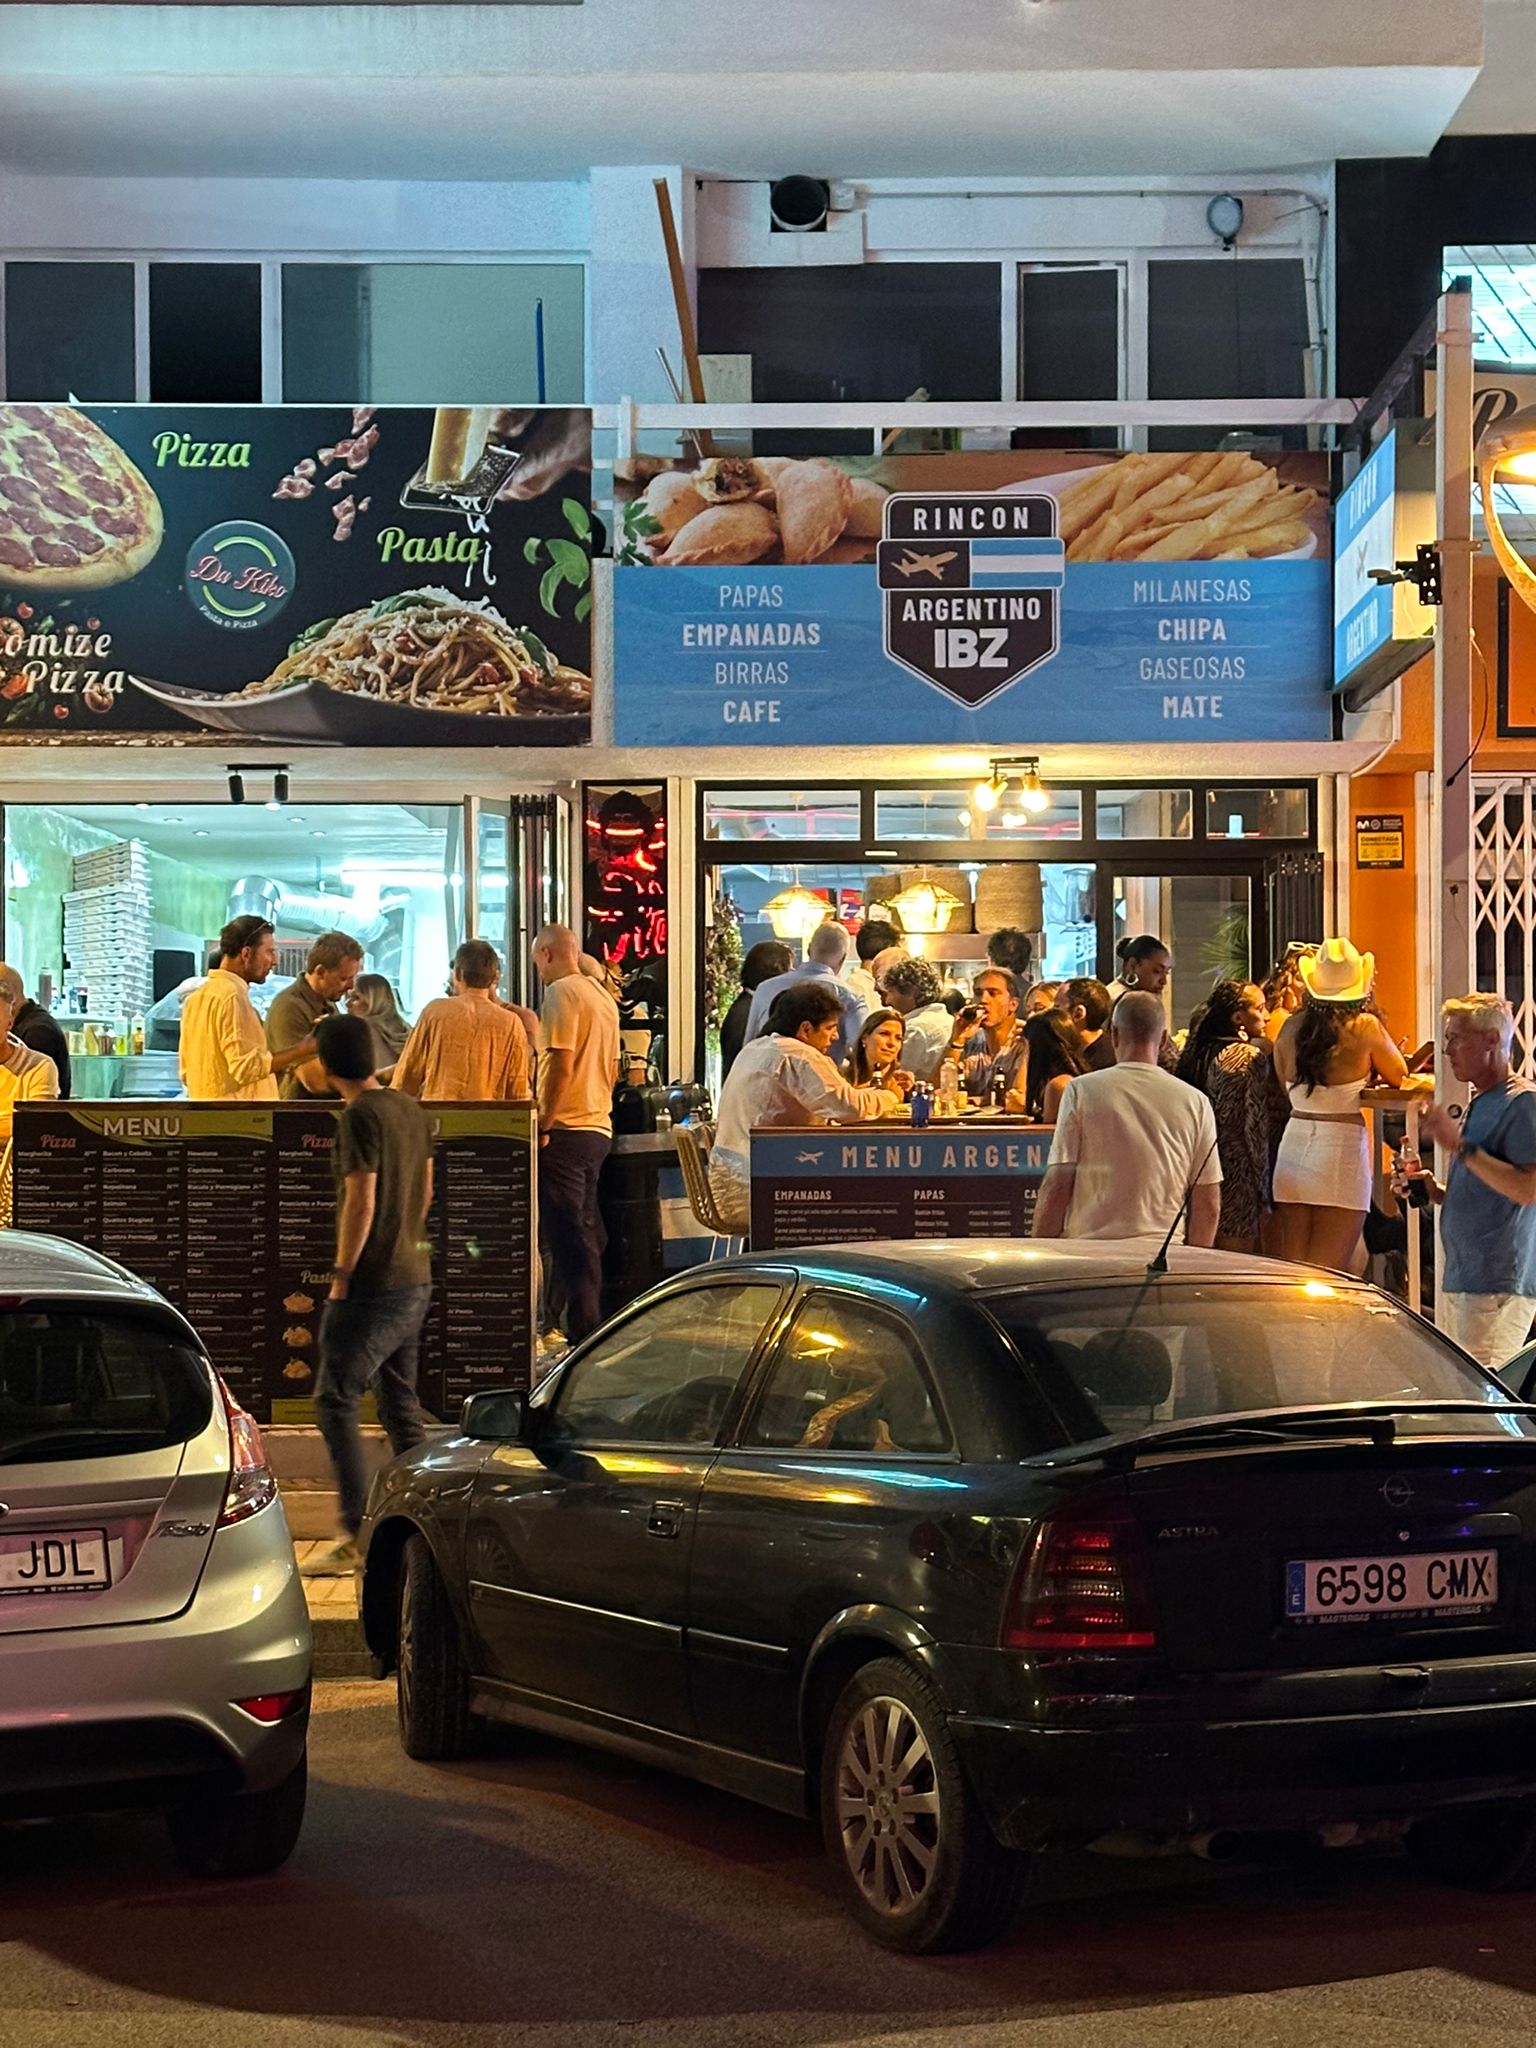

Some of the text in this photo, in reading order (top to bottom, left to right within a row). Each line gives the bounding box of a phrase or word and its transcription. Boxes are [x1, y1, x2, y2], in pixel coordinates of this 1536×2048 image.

[152, 431, 250, 468] Pizza
[913, 506, 1029, 532] RINCON
[376, 526, 481, 566] Pasta
[190, 554, 288, 598] Da Kiko
[718, 585, 784, 609] PAPAS
[1133, 577, 1252, 603] MILANESAS
[901, 596, 1042, 624] ARGENTINO
[0, 627, 112, 658] omize
[682, 622, 822, 648] EMPANADAS
[1157, 617, 1227, 643] CHIPA
[934, 629, 1009, 669] IBZ
[22, 660, 126, 693] Pizza
[714, 661, 789, 686] BIRRAS
[1138, 655, 1245, 682] GASEOSAS
[722, 699, 781, 724] CAFE
[1163, 694, 1224, 719] MATE
[103, 1116, 181, 1138] MENU
[40, 1133, 77, 1149] Pizza
[841, 1145, 1042, 1169] MENU ARGEN
[774, 1189, 832, 1201] EMPANADAS
[913, 1189, 945, 1201] PAPAS
[1158, 1525, 1219, 1538] ASTRA
[18, 1538, 95, 1579] JDL
[1292, 1555, 1491, 1607] E 6598 CMX
[1434, 1604, 1482, 1616] MASTERGAS
